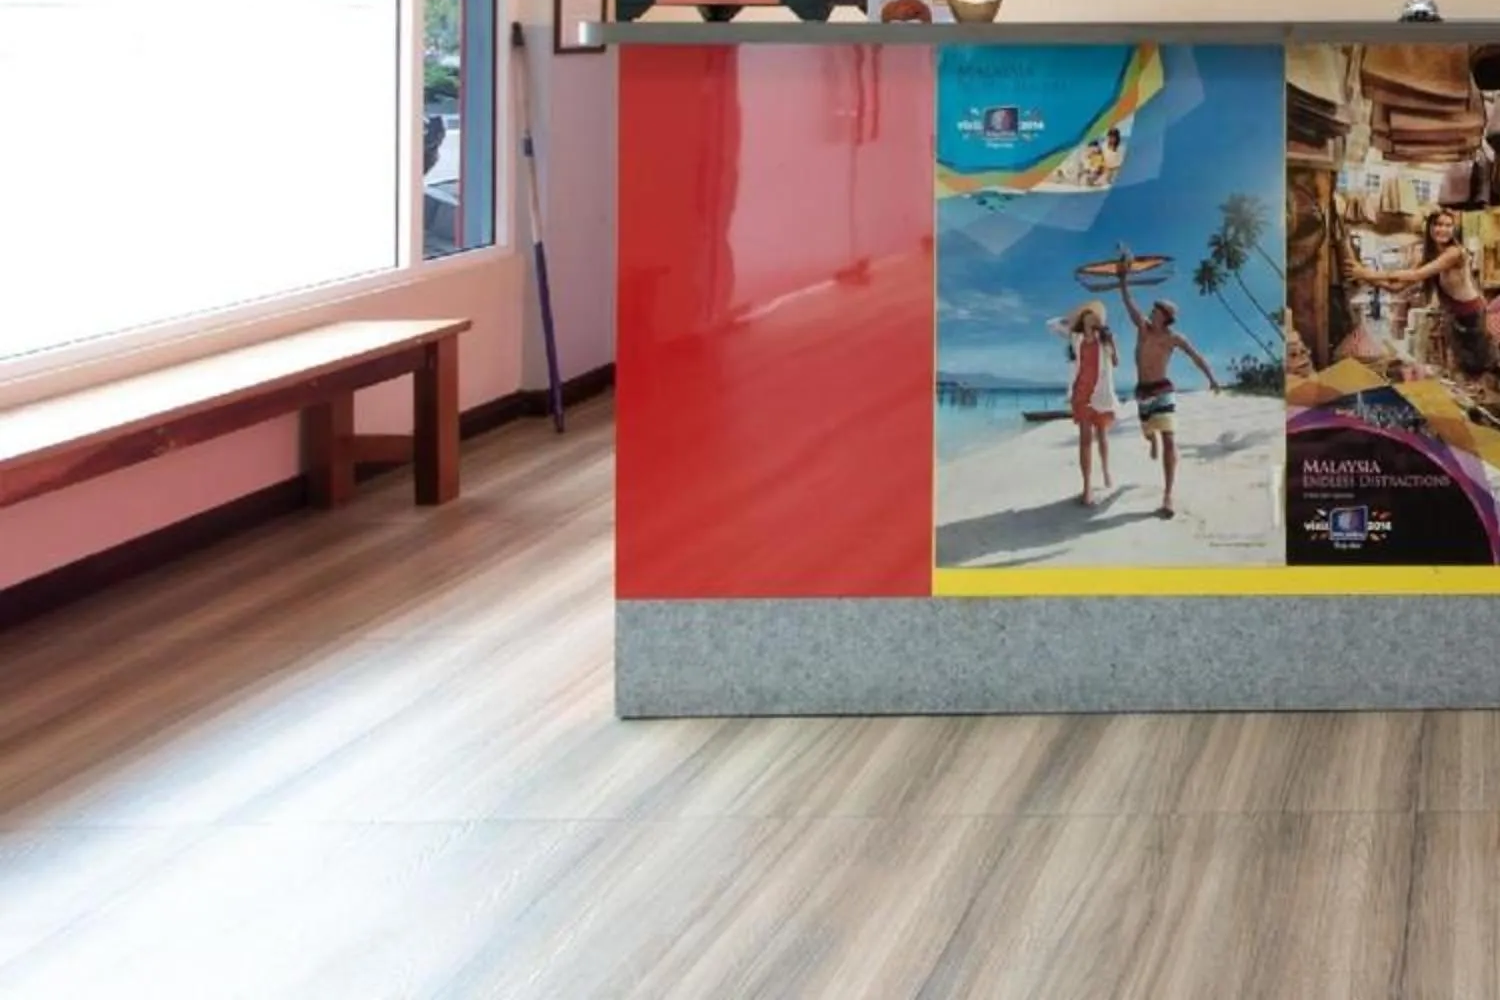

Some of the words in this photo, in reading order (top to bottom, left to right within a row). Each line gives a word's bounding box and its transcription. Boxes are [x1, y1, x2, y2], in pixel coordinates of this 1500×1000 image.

[1303, 459, 1381, 474] MALAYSIA
[1303, 474, 1355, 489] ENDLESS
[1367, 520, 1393, 531] 2014
